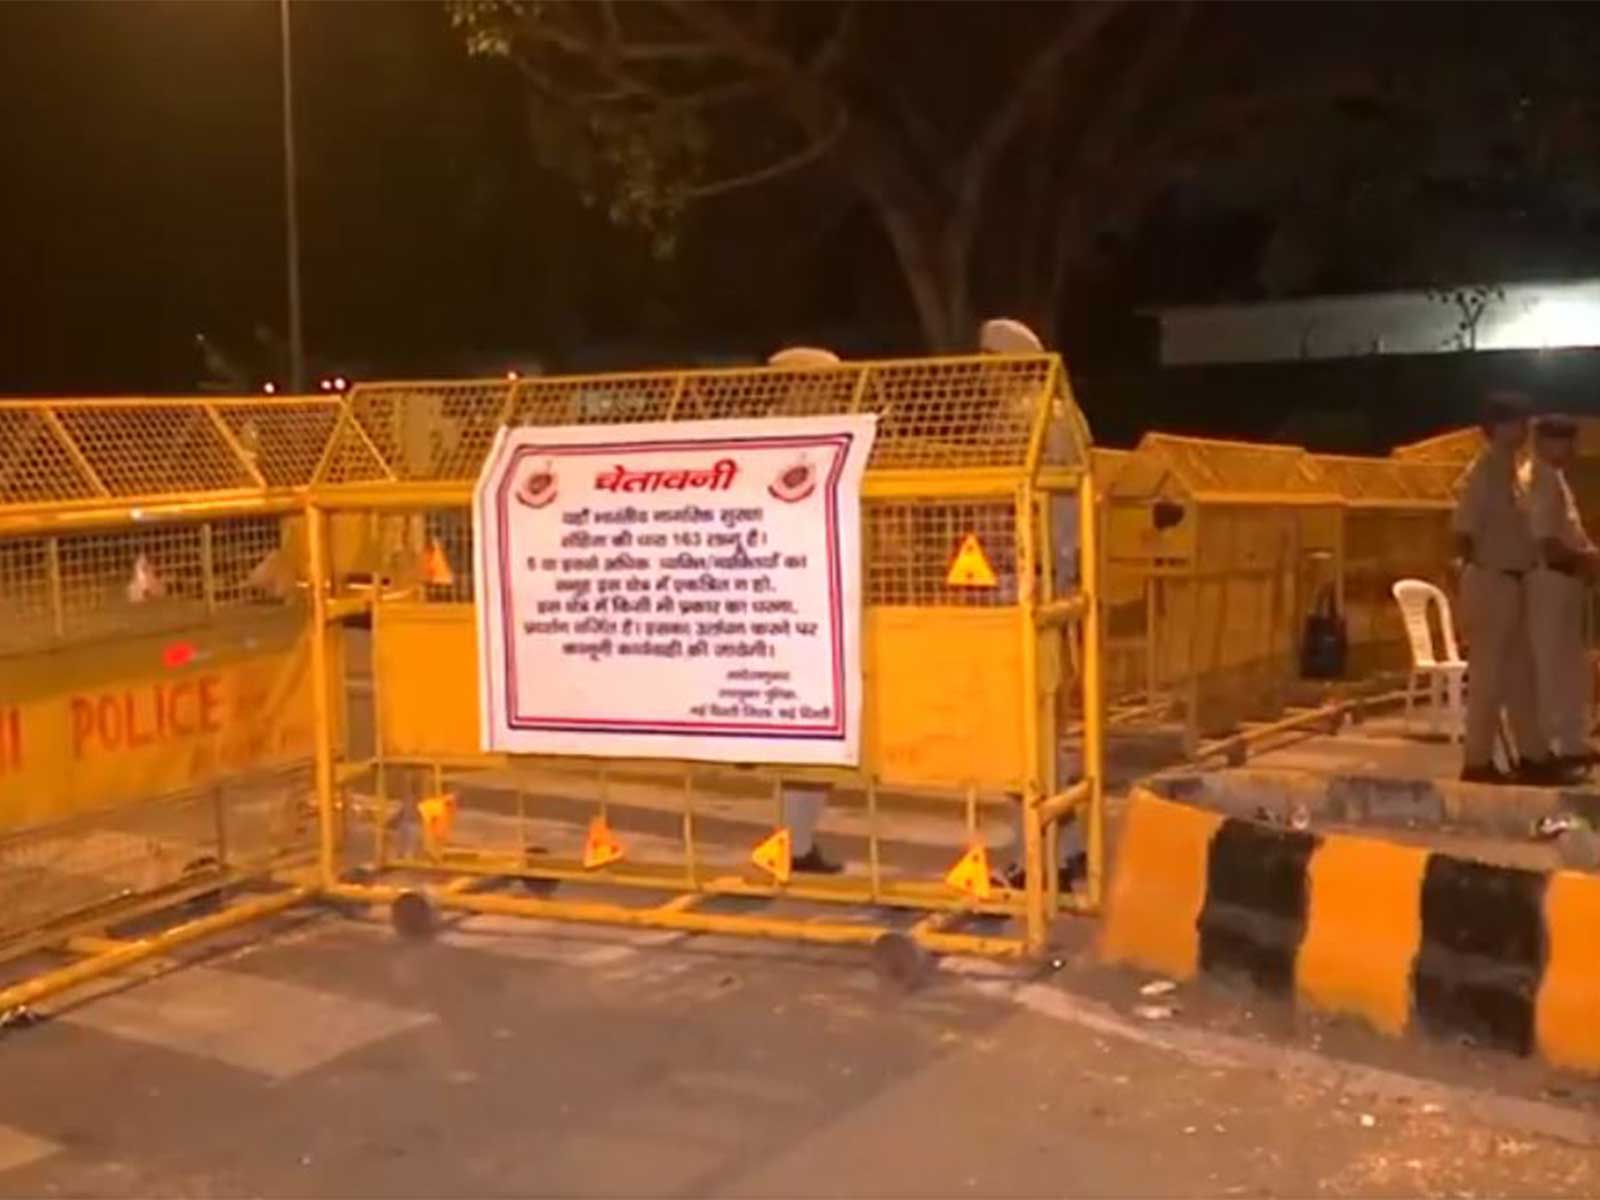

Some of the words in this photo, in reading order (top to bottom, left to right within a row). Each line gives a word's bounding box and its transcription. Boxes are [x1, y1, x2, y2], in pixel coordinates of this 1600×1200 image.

[594, 458, 738, 494] चेतावनी
[672, 531, 702, 547] 163
[69, 675, 222, 762] POLICE
